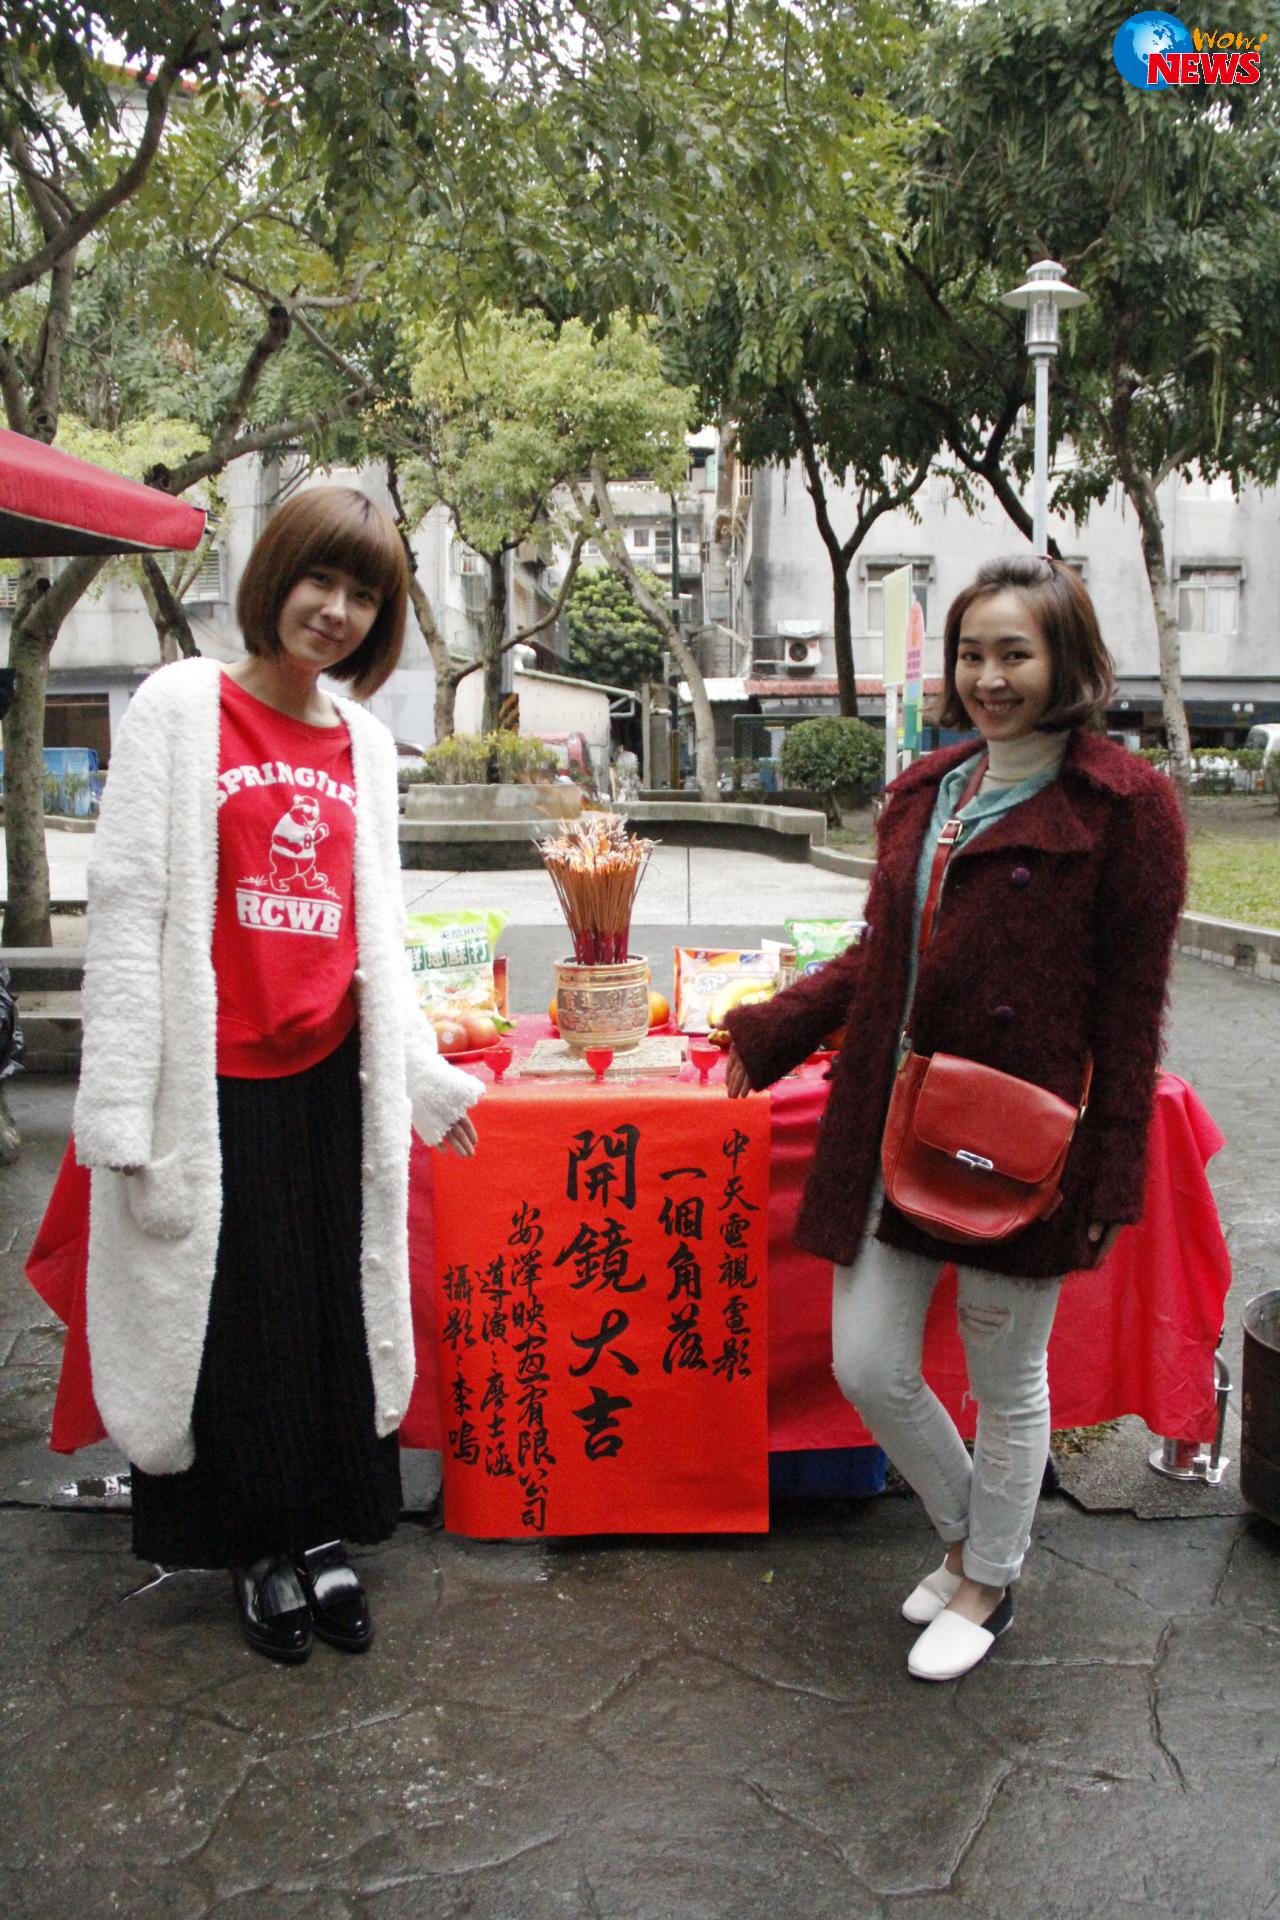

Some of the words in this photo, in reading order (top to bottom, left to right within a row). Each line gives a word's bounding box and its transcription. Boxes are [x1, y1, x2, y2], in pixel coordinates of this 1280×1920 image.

[237, 893, 342, 933] RCWB
[552, 1123, 647, 1462] 開鏡大吉
[658, 1167, 709, 1375] 一個角落
[712, 1129, 760, 1382] 中天電視電影
